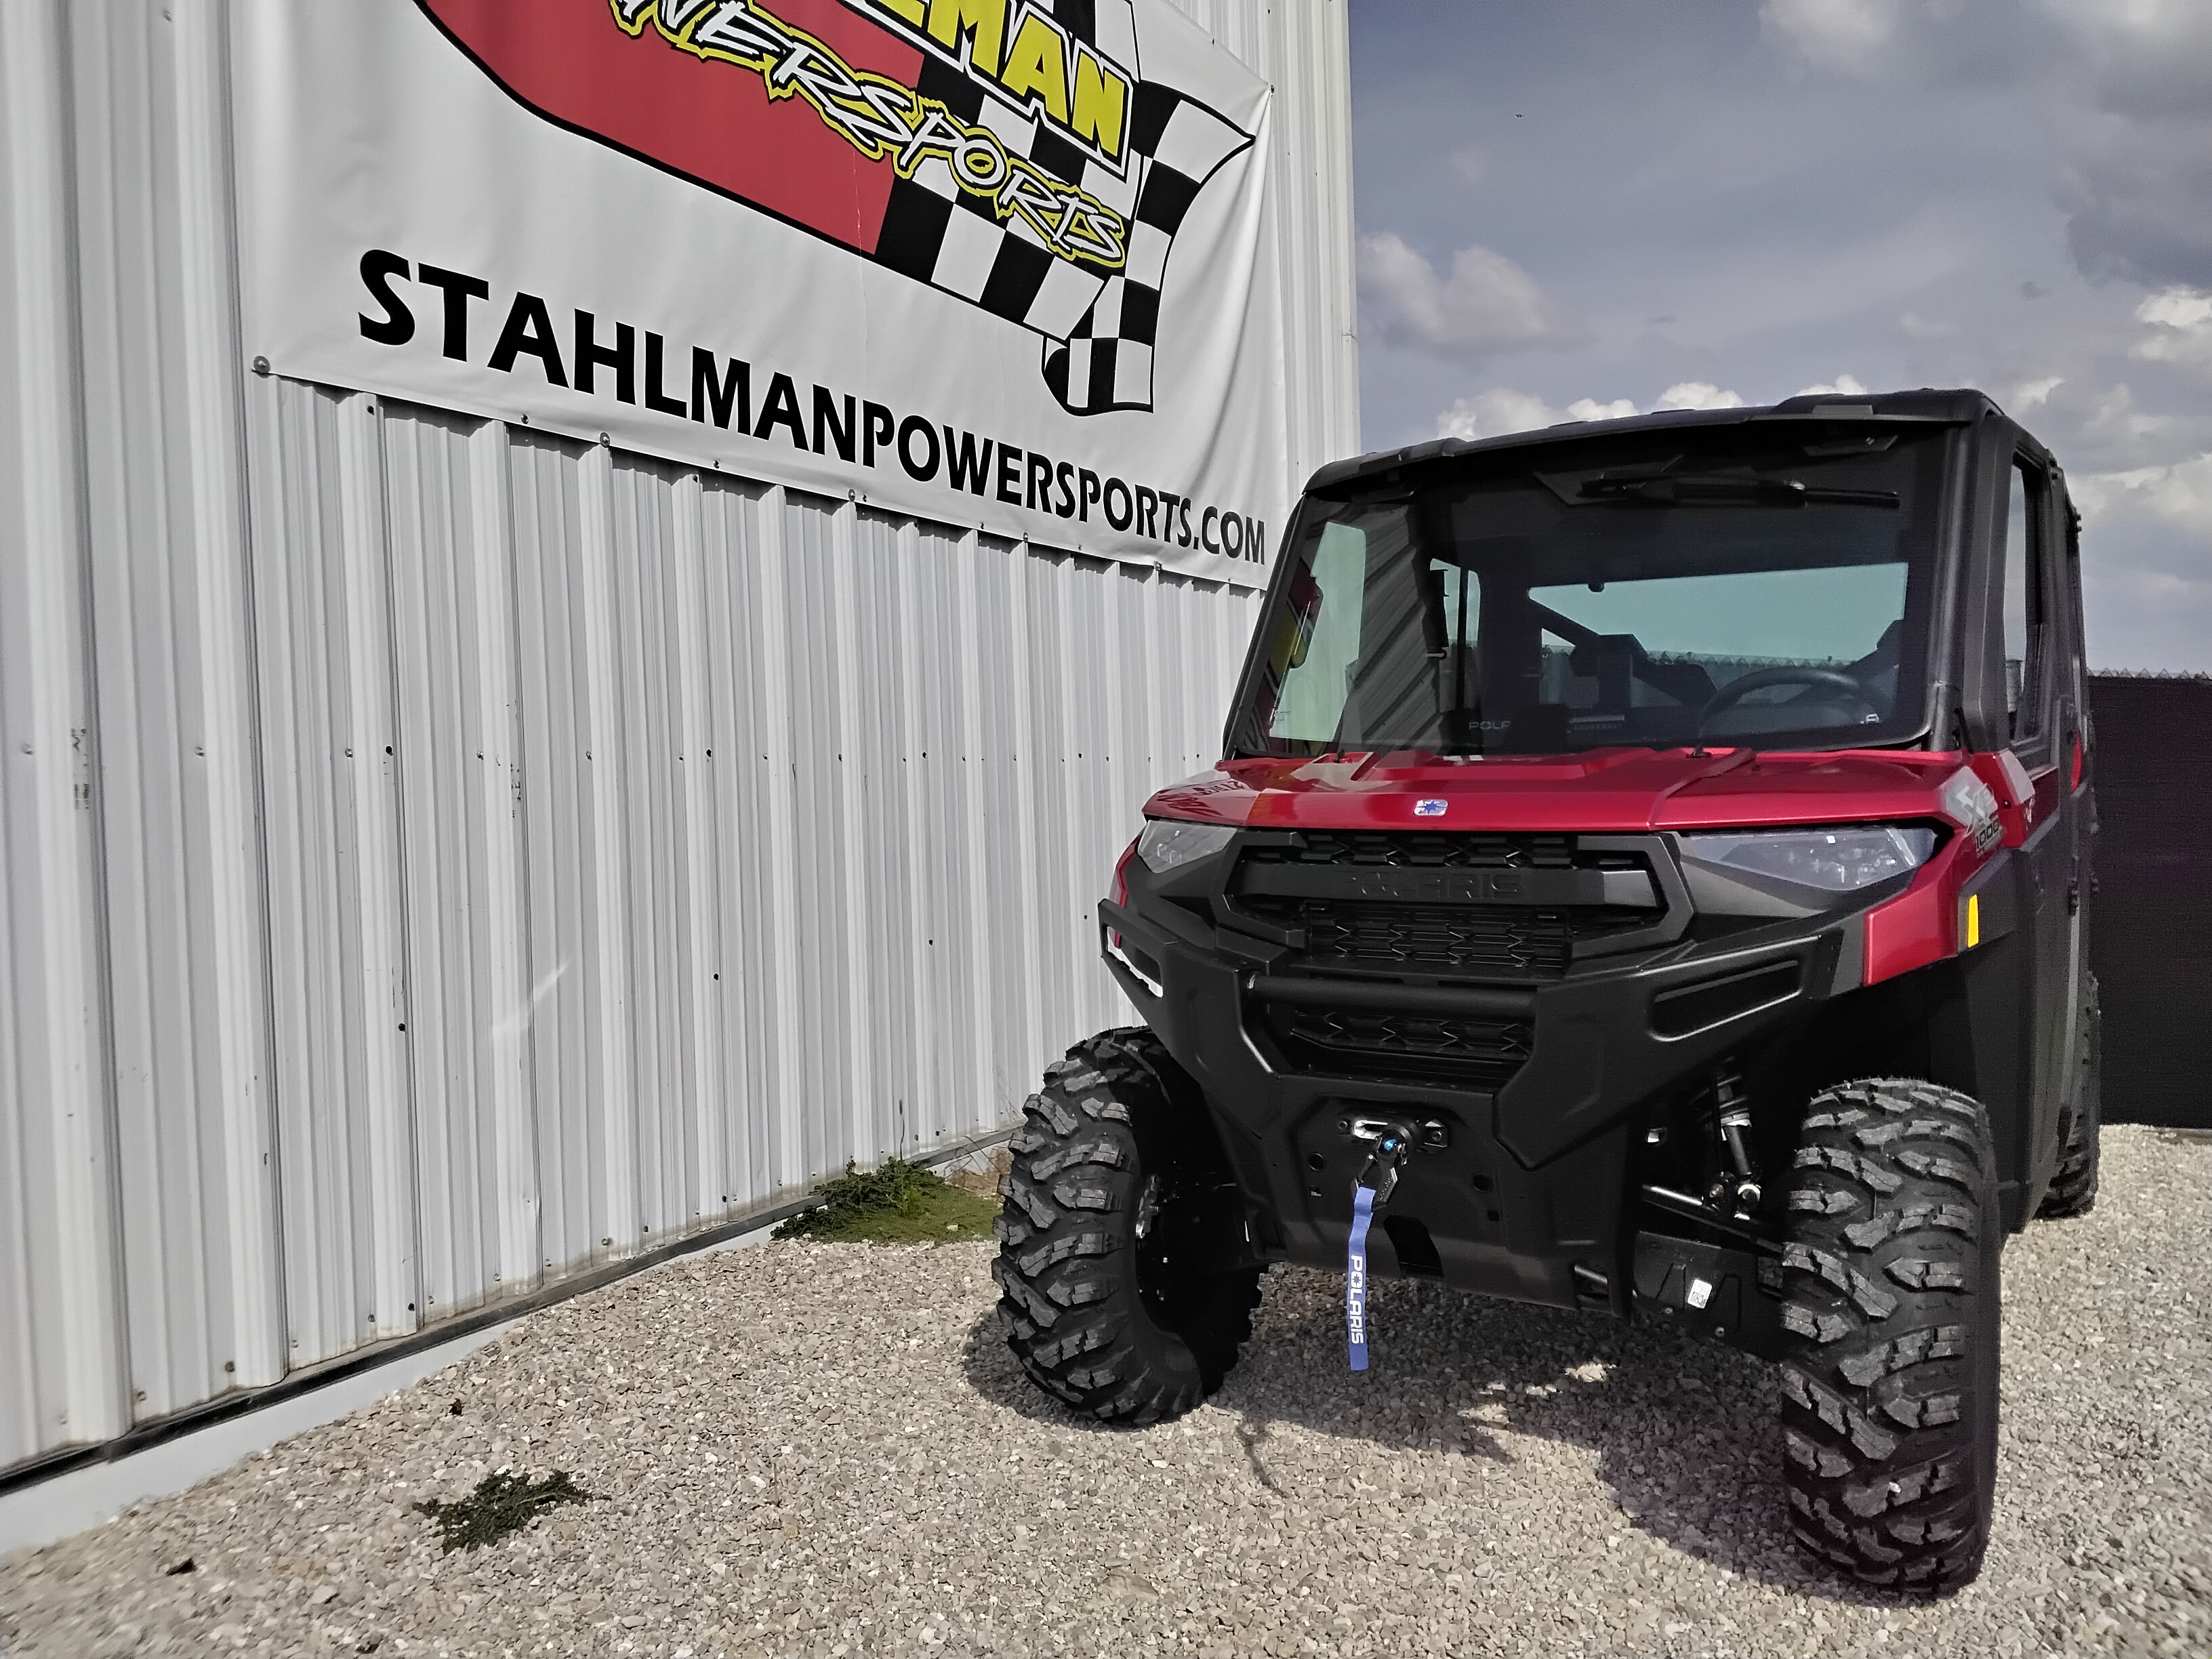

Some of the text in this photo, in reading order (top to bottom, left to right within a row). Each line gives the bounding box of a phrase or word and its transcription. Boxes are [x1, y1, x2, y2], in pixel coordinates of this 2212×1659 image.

[357, 249, 1265, 565] STAHLMANPOWERSPORTS.COM
[1332, 870, 1525, 900] POLARIS
[1349, 1254, 1364, 1345] POLARIS
